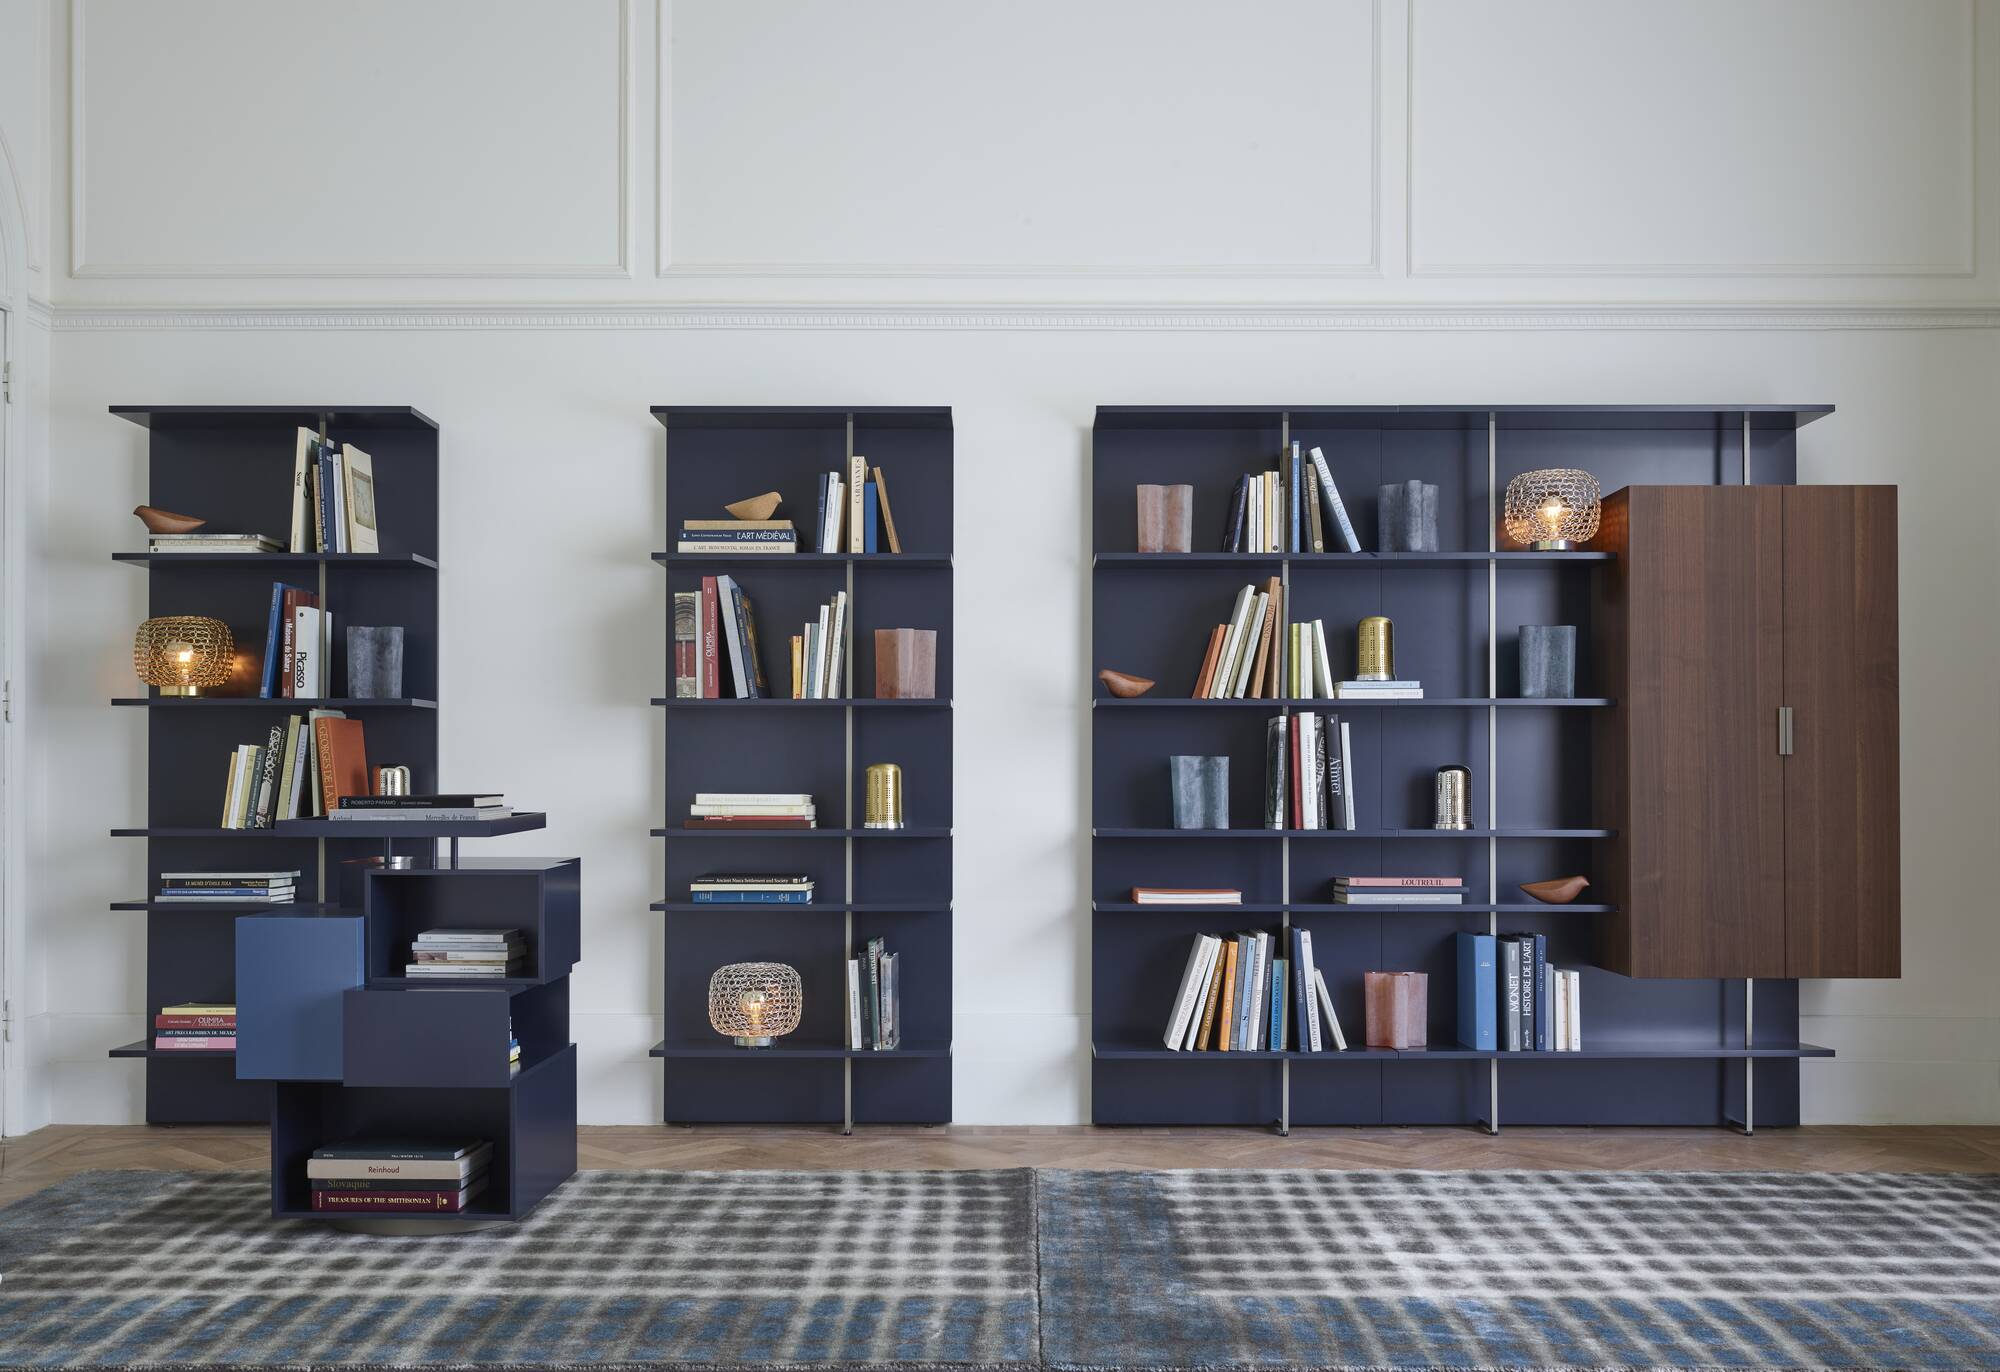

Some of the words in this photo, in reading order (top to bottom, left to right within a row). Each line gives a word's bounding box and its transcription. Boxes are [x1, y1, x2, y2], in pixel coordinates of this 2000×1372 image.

[736, 532, 755, 540] L'ART
[756, 530, 791, 540] MÉDIÉVAL
[296, 652, 307, 689] Picasso
[319, 727, 331, 768] GEORGES
[1330, 757, 1341, 795] Aimer
[1523, 941, 1531, 964] L'ART
[1523, 965, 1531, 978] DE
[1509, 973, 1520, 1012] MONET
[1523, 979, 1531, 1016] HISTOIRE
[368, 1166, 400, 1174] Reinhoud
